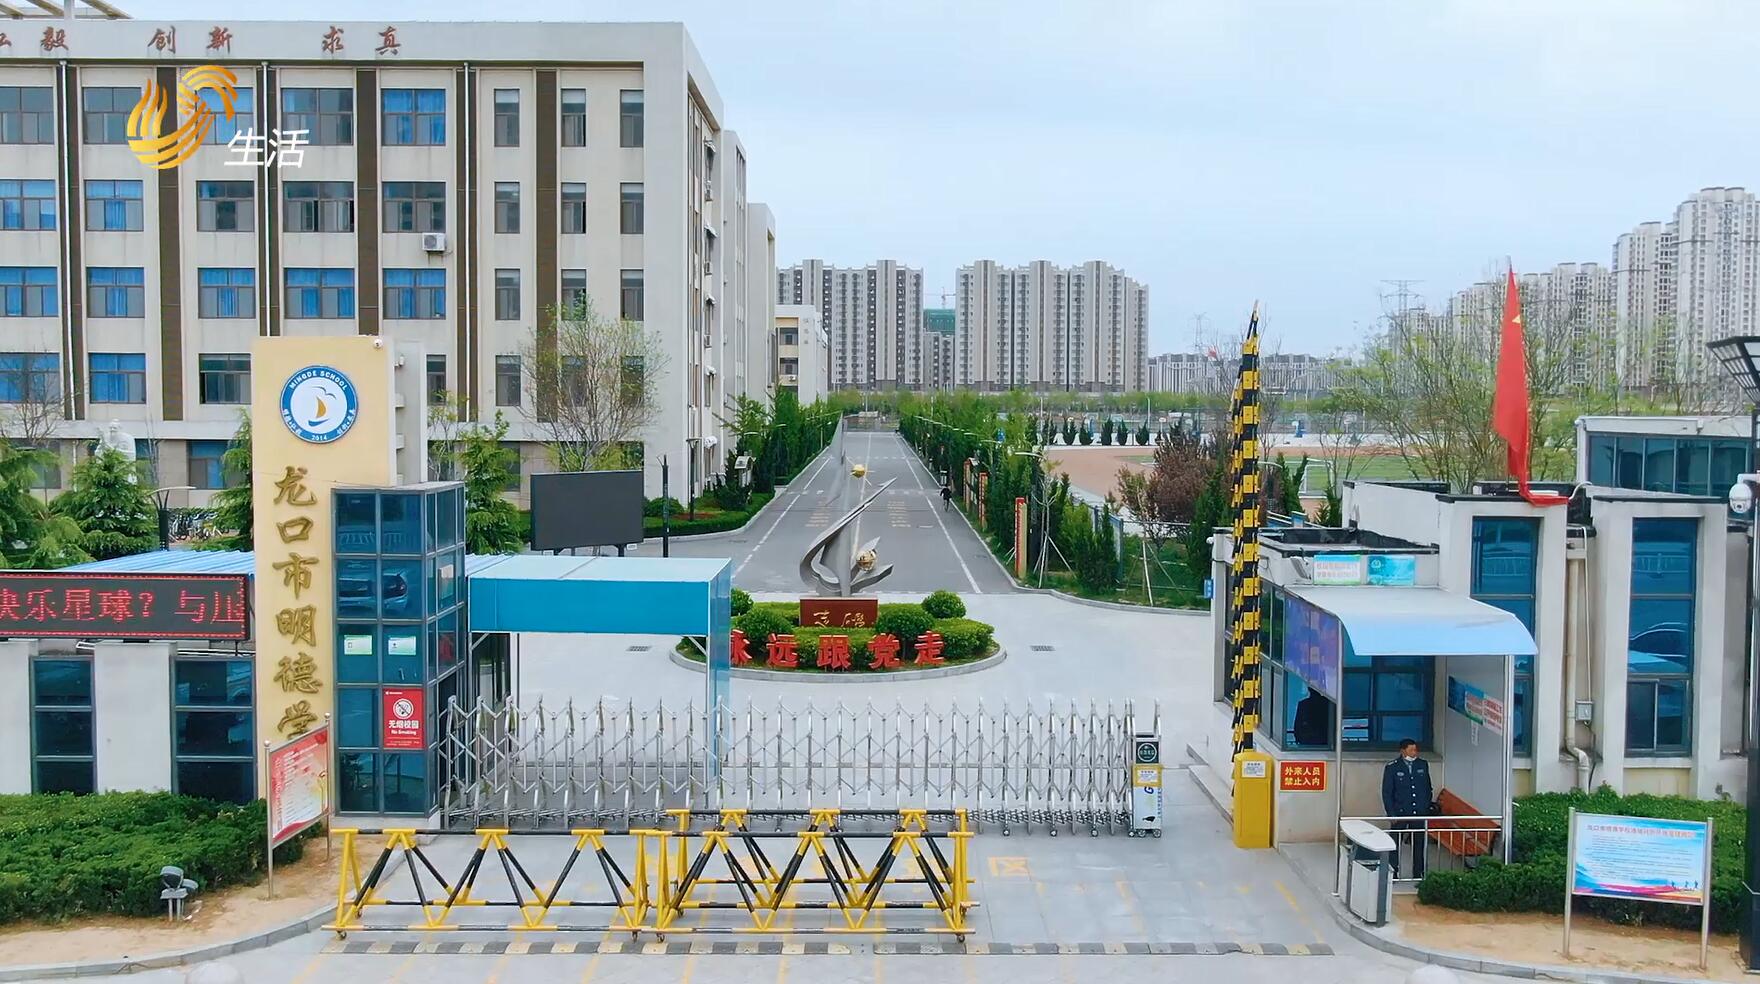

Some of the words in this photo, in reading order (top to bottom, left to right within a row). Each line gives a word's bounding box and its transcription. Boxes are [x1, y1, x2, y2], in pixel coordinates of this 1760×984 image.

[147, 25, 233, 54] 创新
[321, 25, 402, 56] 求真
[319, 370, 349, 391] SCHOOL
[388, 719, 420, 729] 无烟校园
[1284, 766, 1321, 777] 外来人员
[1284, 777, 1321, 787] 禁止入内
